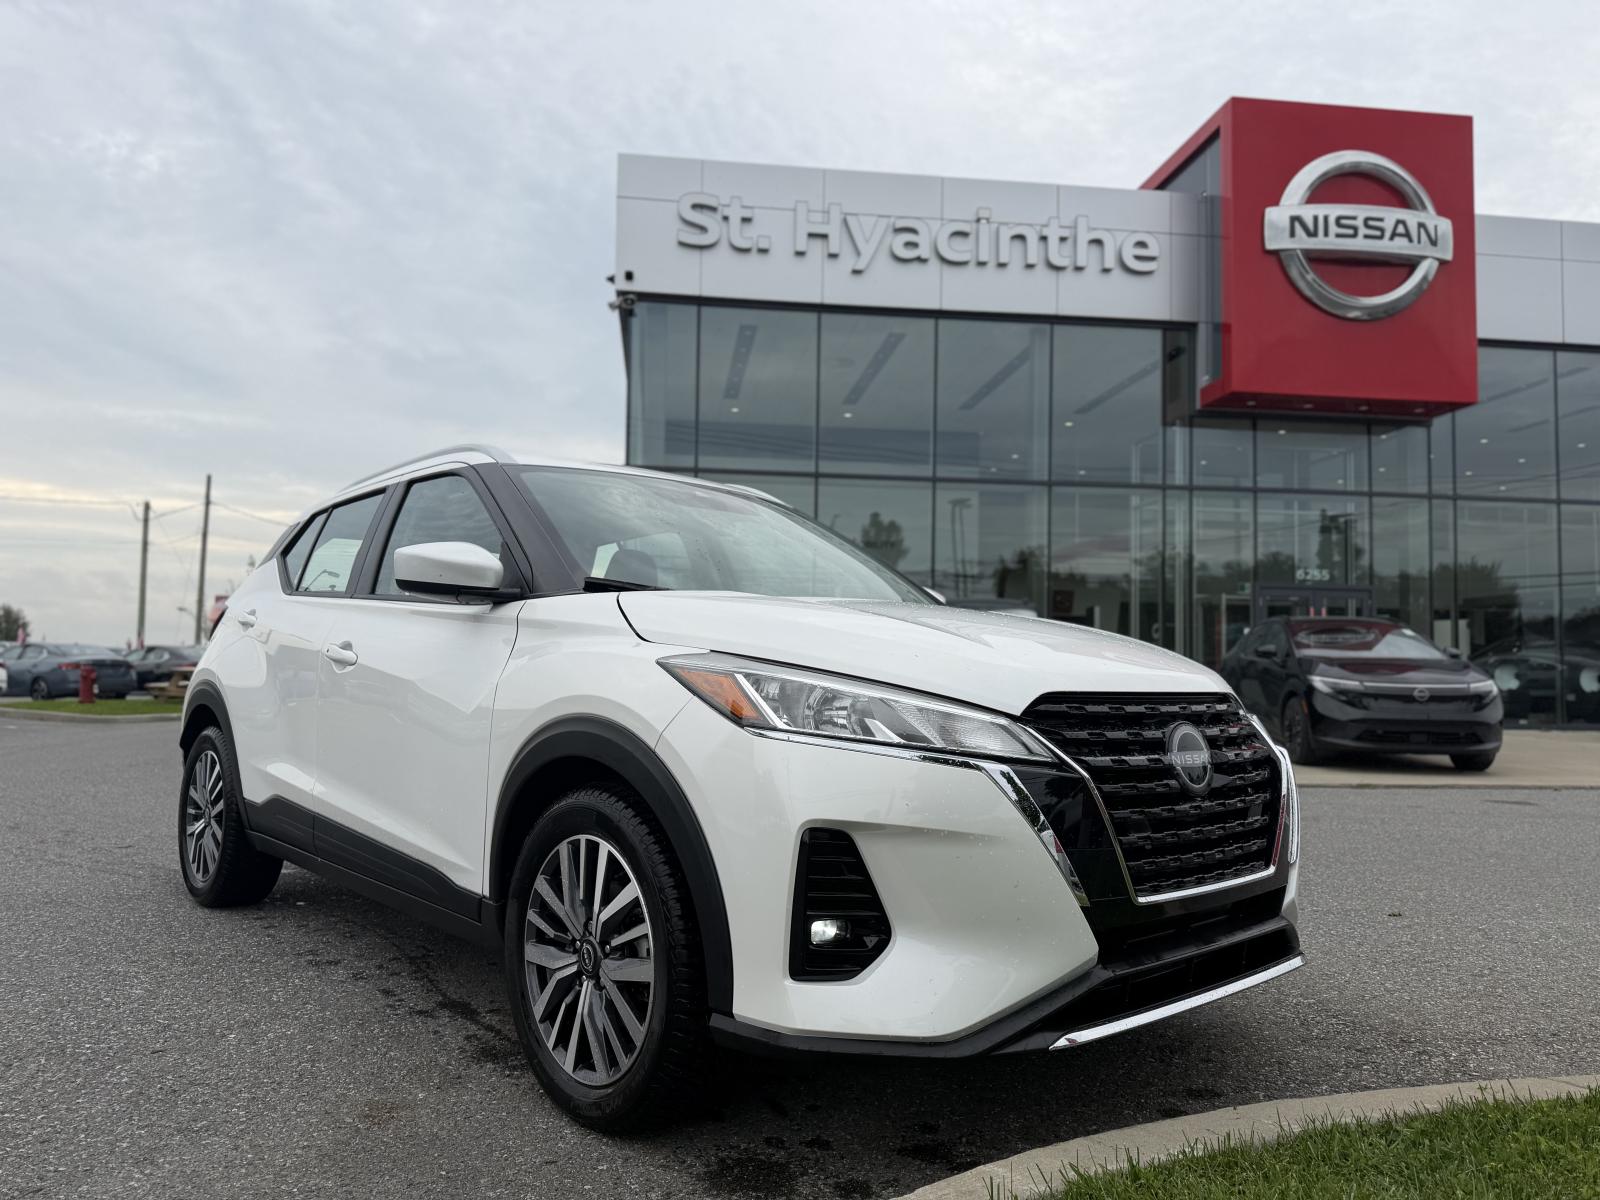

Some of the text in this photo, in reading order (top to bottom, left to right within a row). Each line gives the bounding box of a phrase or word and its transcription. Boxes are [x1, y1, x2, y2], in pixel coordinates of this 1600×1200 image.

[676, 192, 1160, 273] St. Hyacinthe
[1289, 214, 1438, 247] NISSAN
[1296, 569, 1330, 581] 6255
[1171, 752, 1211, 765] NISSAN
